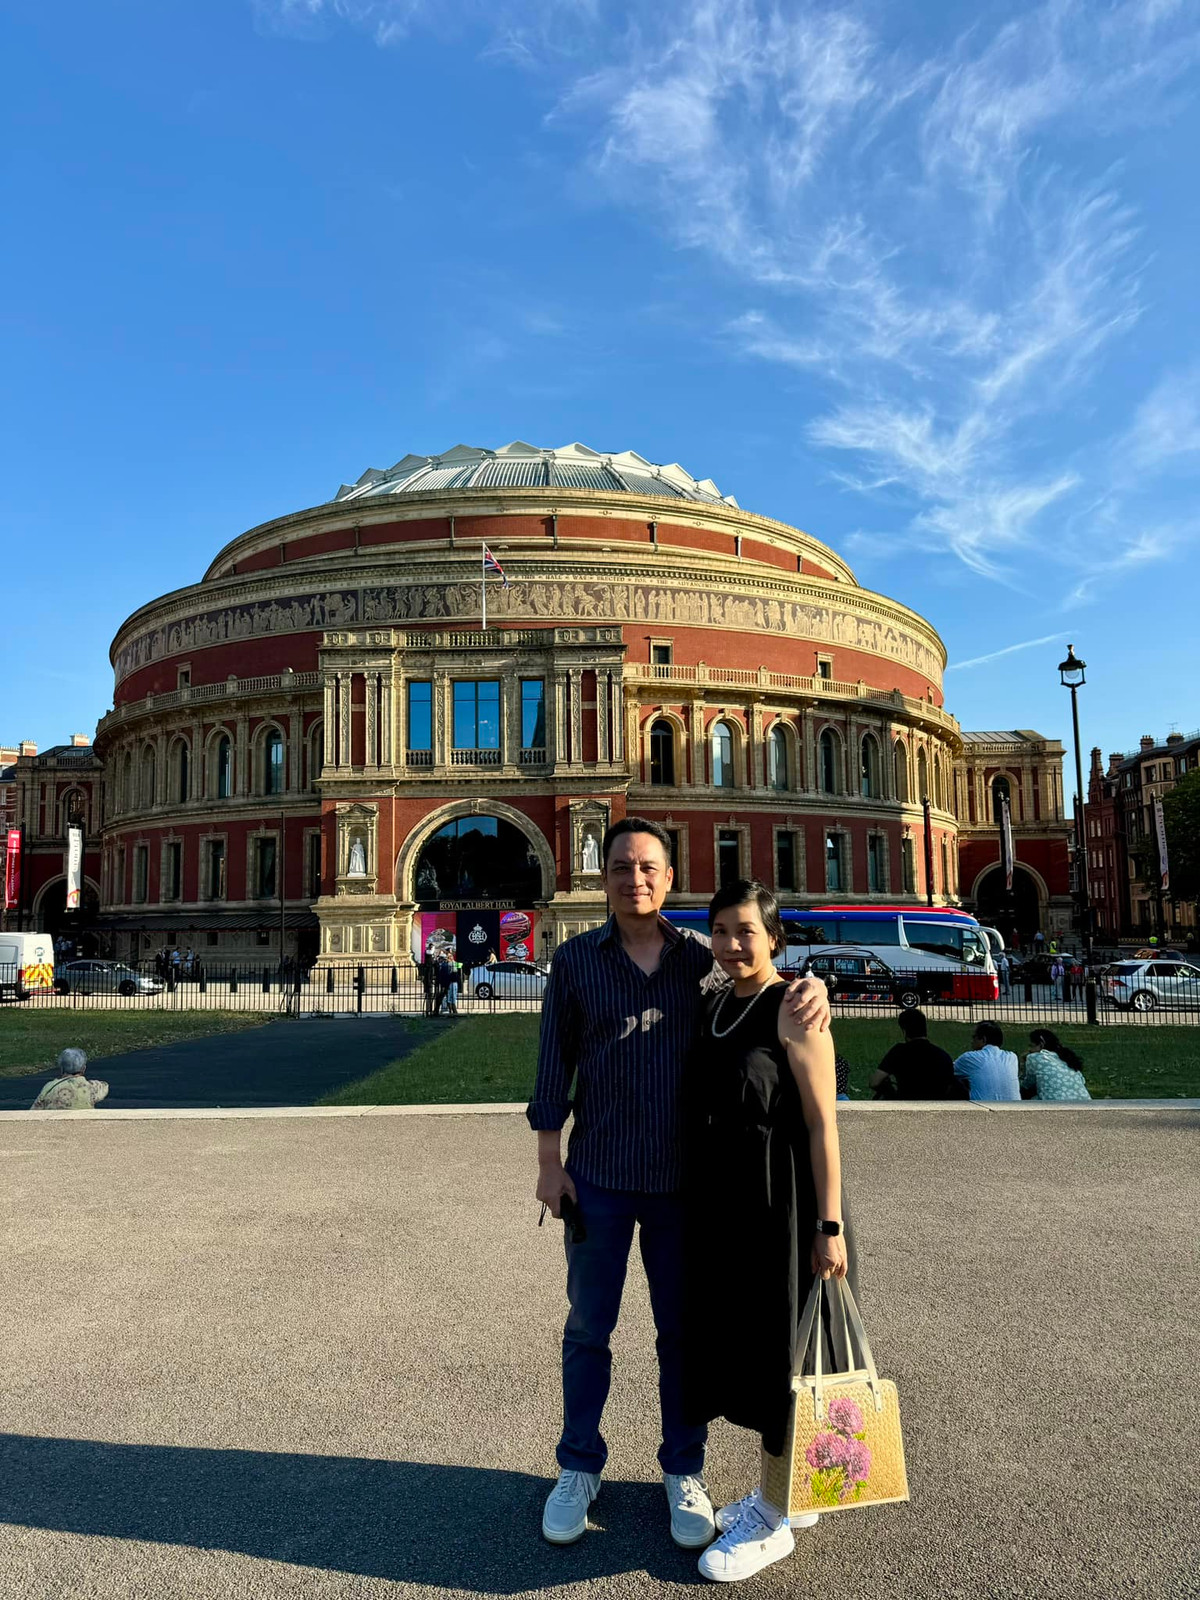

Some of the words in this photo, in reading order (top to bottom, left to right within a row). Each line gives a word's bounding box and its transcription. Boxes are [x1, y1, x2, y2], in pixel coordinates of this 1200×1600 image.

[440, 902, 464, 910] ROYAL
[466, 902, 494, 910] ALBERT
[496, 901, 516, 909] HALL
